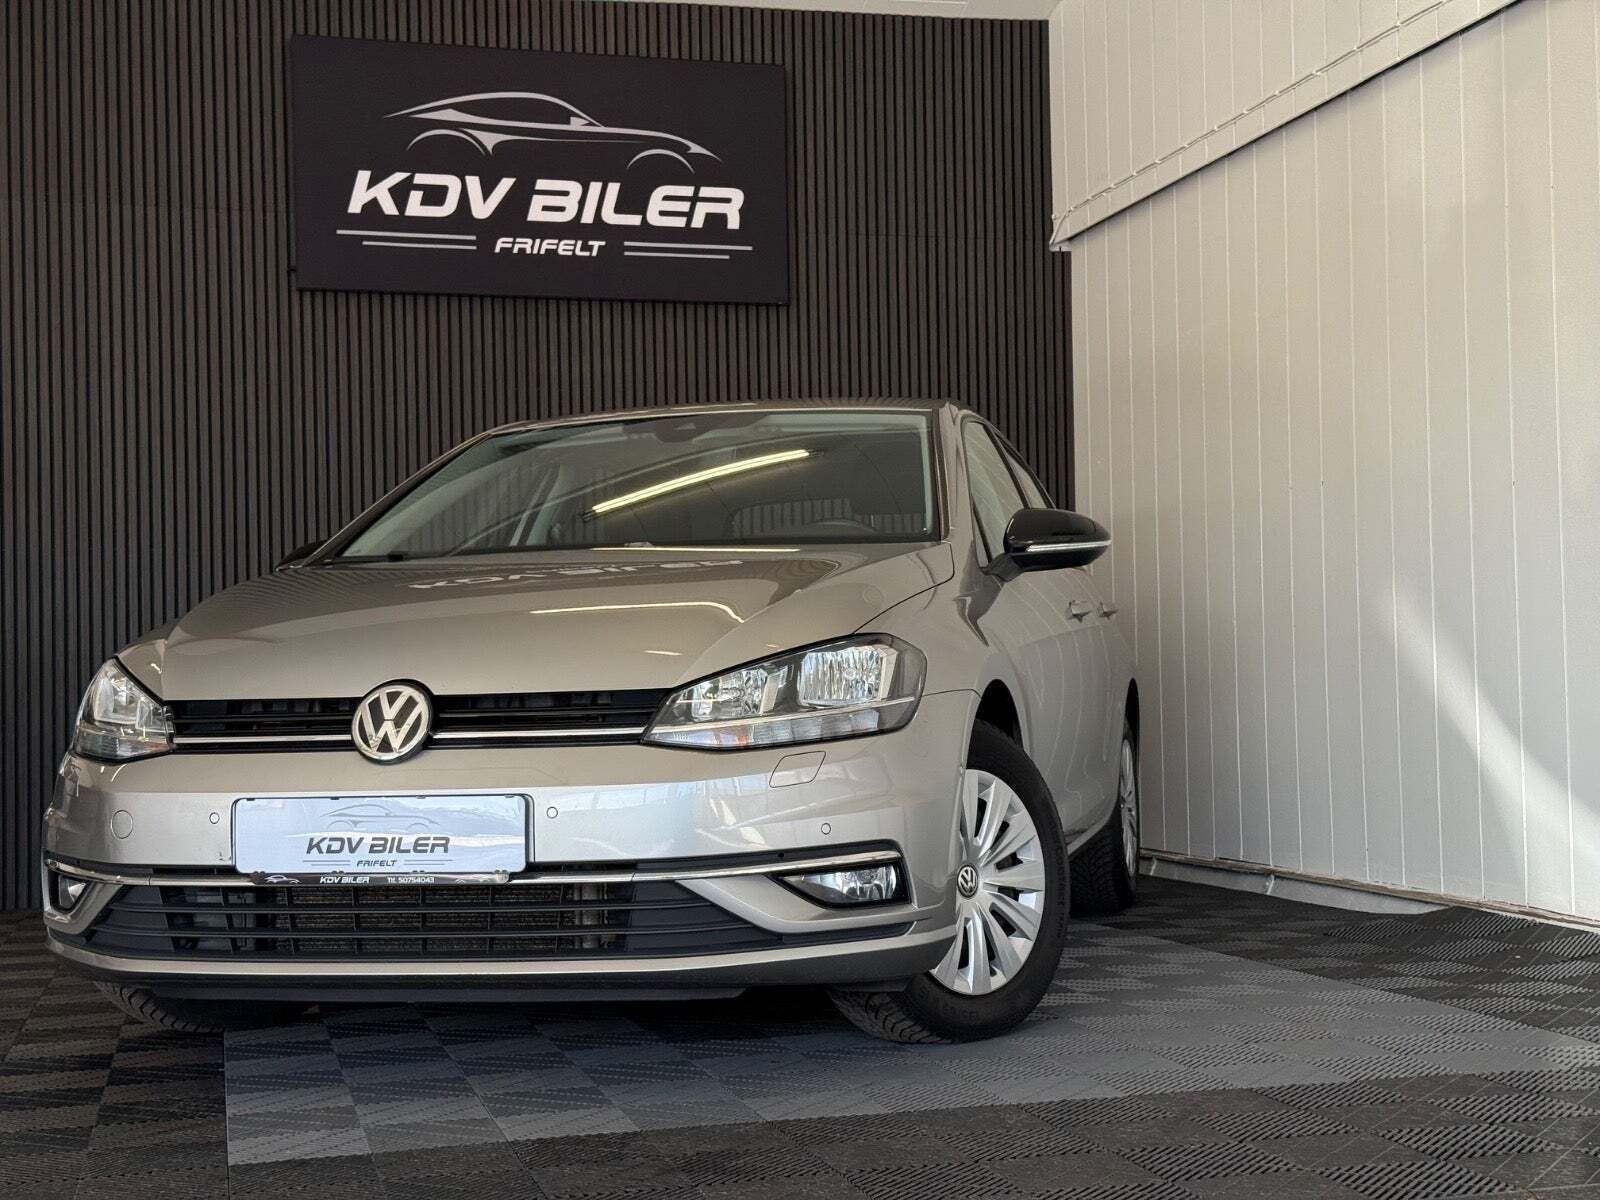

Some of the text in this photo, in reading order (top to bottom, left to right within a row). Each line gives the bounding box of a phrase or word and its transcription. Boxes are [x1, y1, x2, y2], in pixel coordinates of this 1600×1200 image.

[347, 170, 745, 230] KDV BILER
[494, 237, 606, 257] FRIFELT
[306, 836, 450, 855] KDV BILER
[356, 859, 398, 868] FRIFELT
[319, 876, 370, 884] KDV BILER
